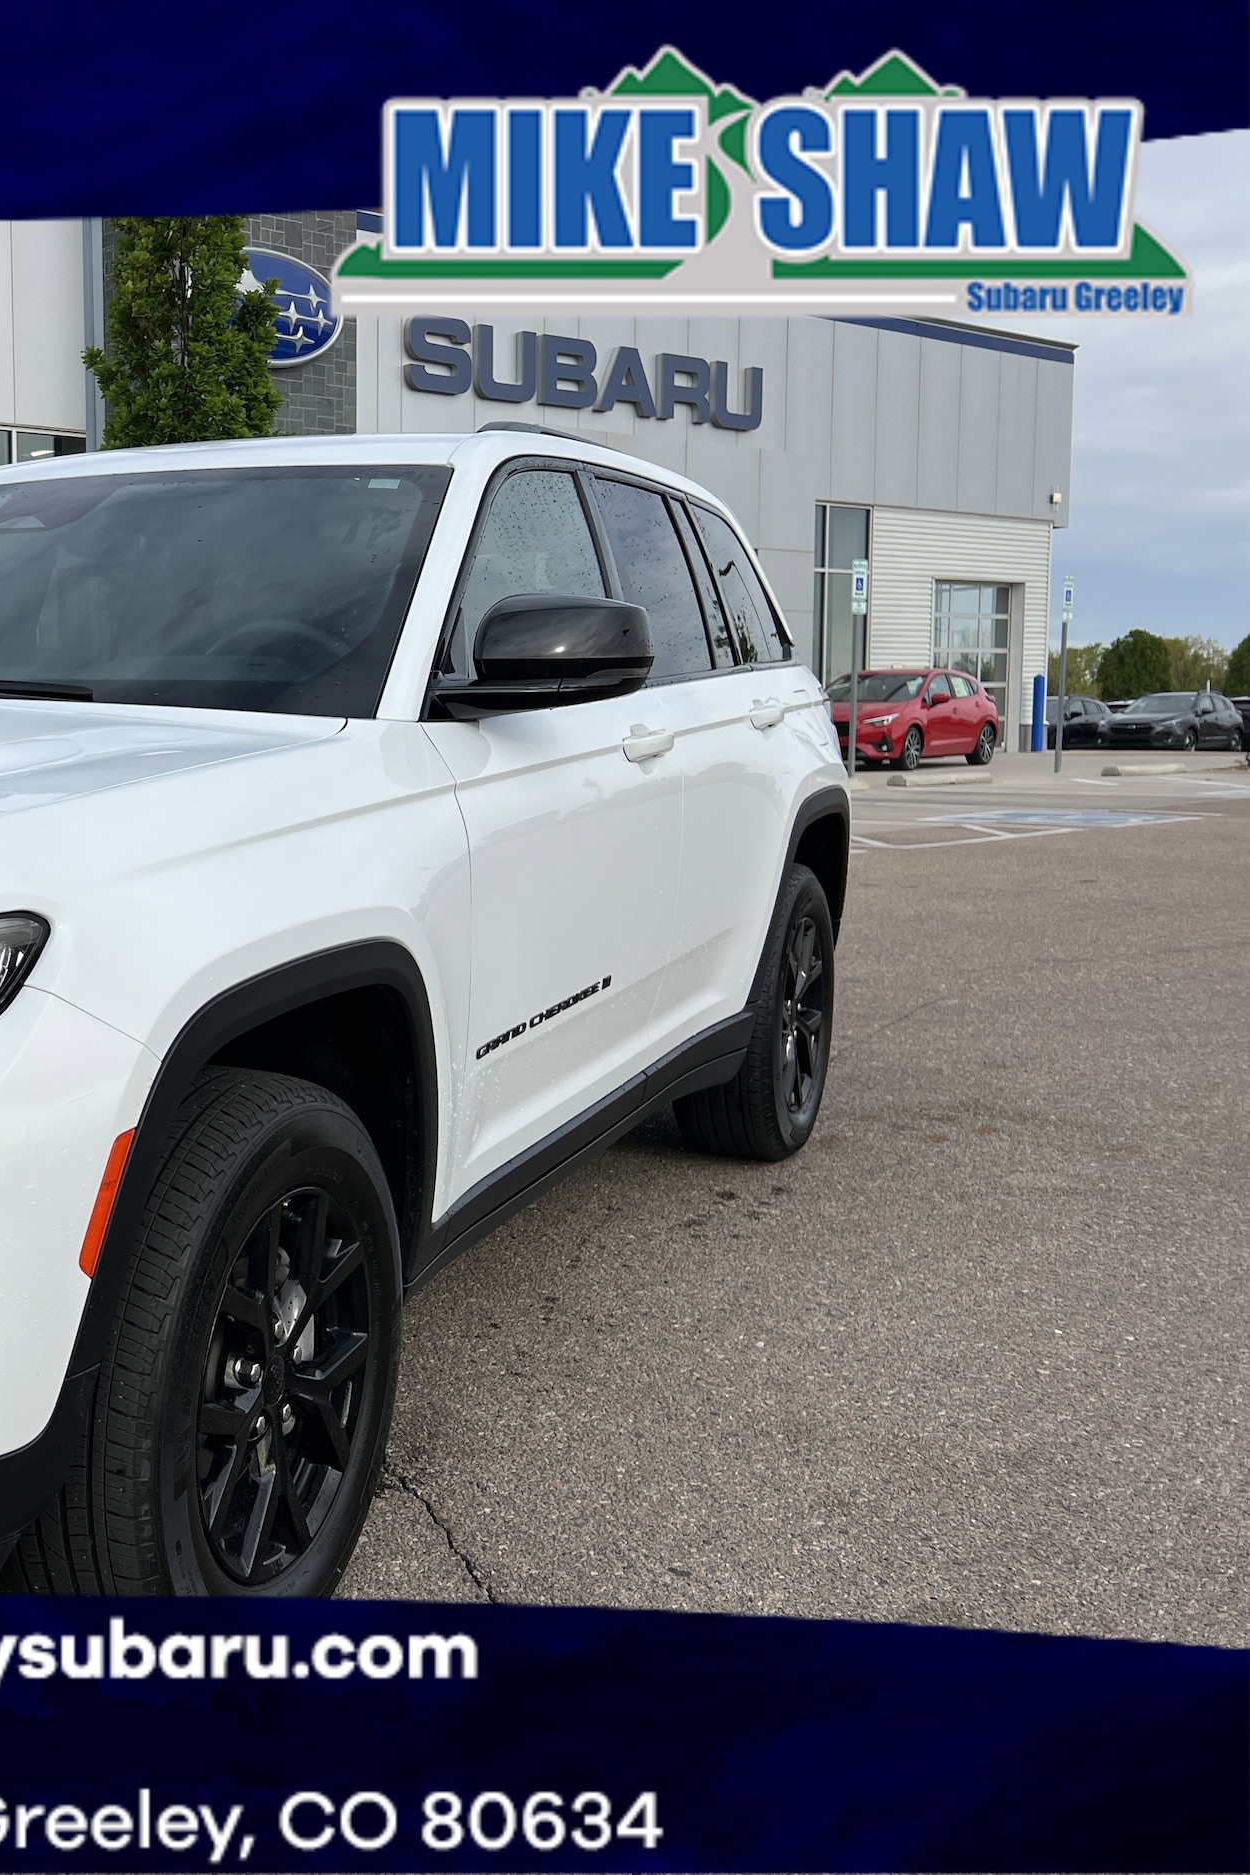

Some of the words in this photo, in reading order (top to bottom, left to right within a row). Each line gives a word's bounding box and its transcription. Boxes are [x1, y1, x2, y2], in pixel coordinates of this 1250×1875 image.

[404, 317, 764, 432] SUBARU
[476, 1022, 527, 1060] GRAND
[529, 981, 601, 1029] CHEROKEE
